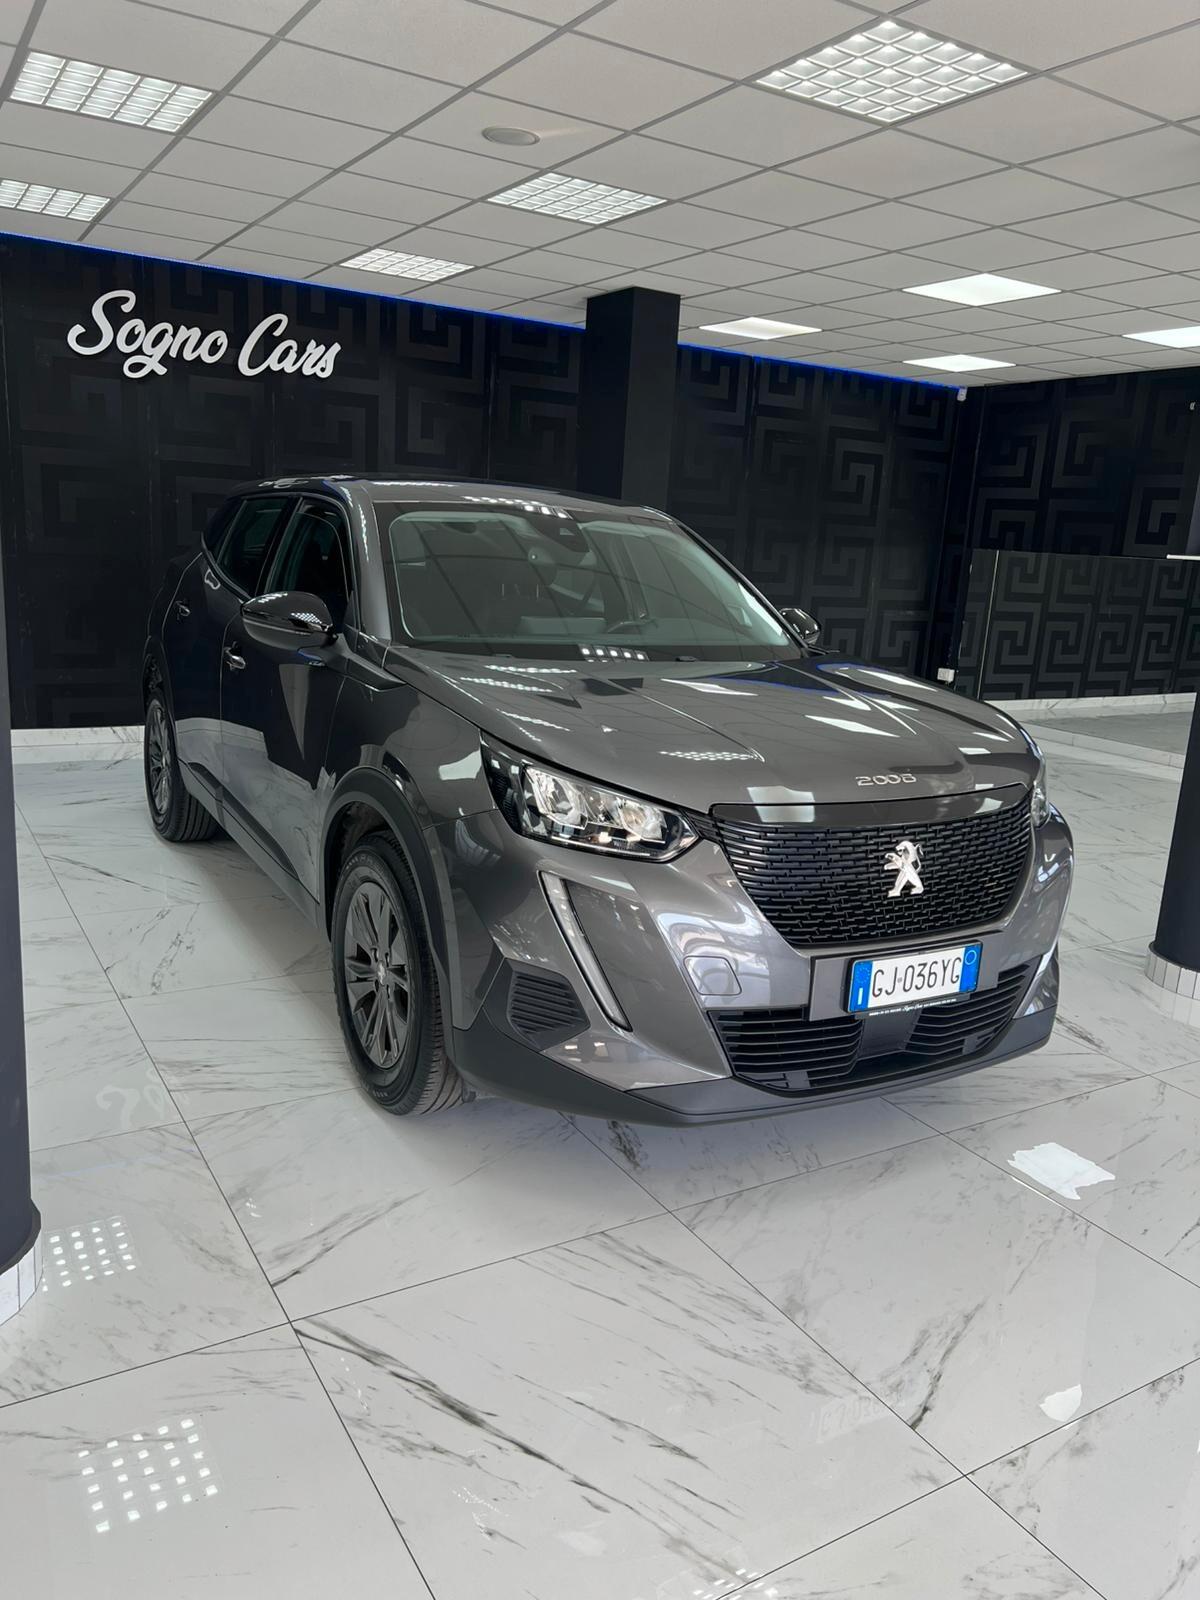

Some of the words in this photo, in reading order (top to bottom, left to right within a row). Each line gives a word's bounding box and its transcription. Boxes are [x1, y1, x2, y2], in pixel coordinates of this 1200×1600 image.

[67, 289, 228, 379] Sogno
[238, 313, 342, 379] Cars
[855, 773, 917, 787] 2008
